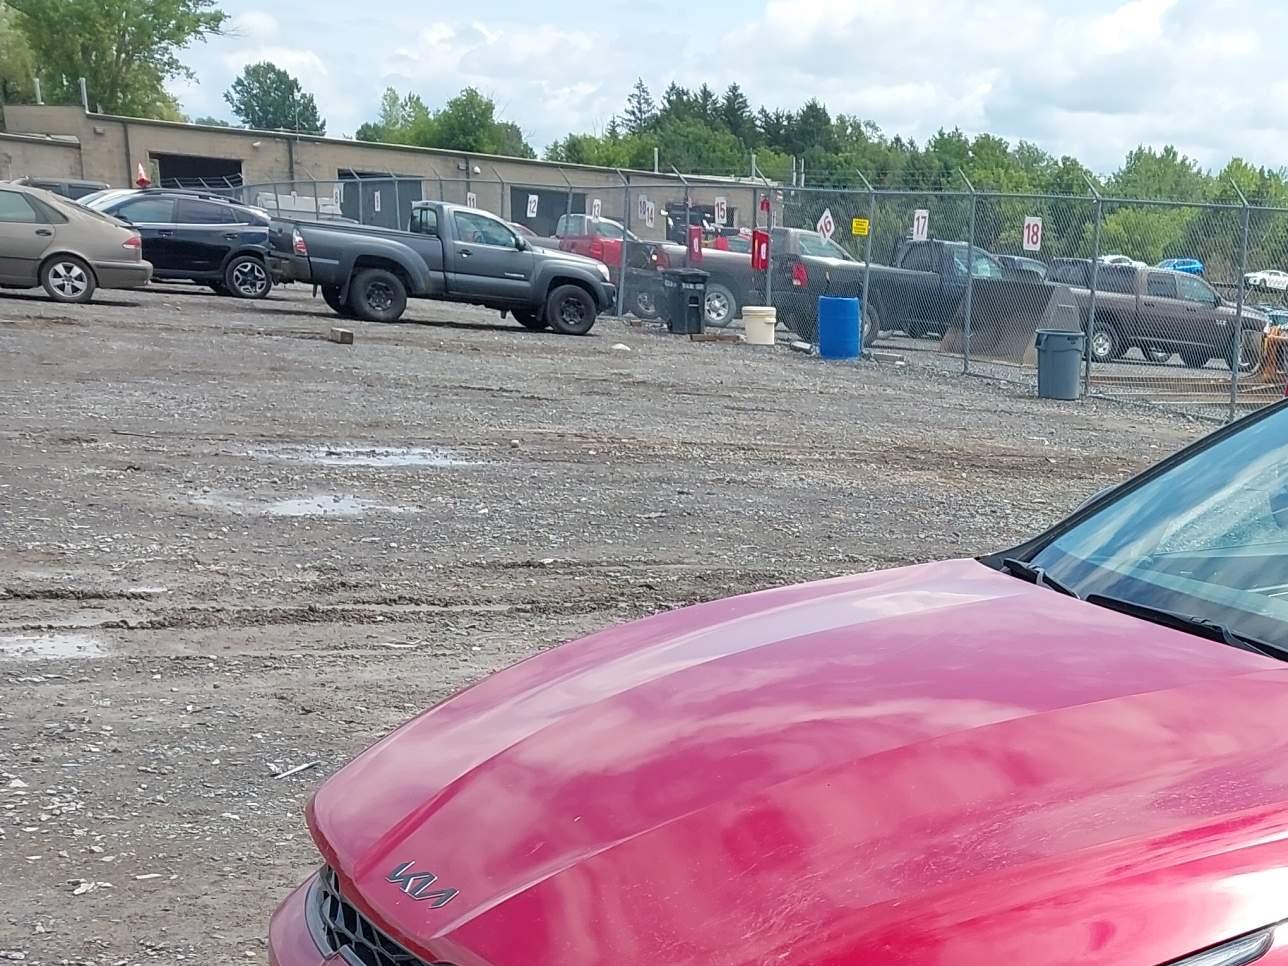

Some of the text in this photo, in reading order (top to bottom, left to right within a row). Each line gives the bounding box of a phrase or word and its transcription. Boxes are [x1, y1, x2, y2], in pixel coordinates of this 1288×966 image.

[528, 200, 537, 213] 12
[716, 202, 726, 220] 15
[819, 216, 832, 236] 16
[916, 216, 927, 235] 17
[1026, 223, 1040, 245] 18
[385, 860, 460, 909] KIA
